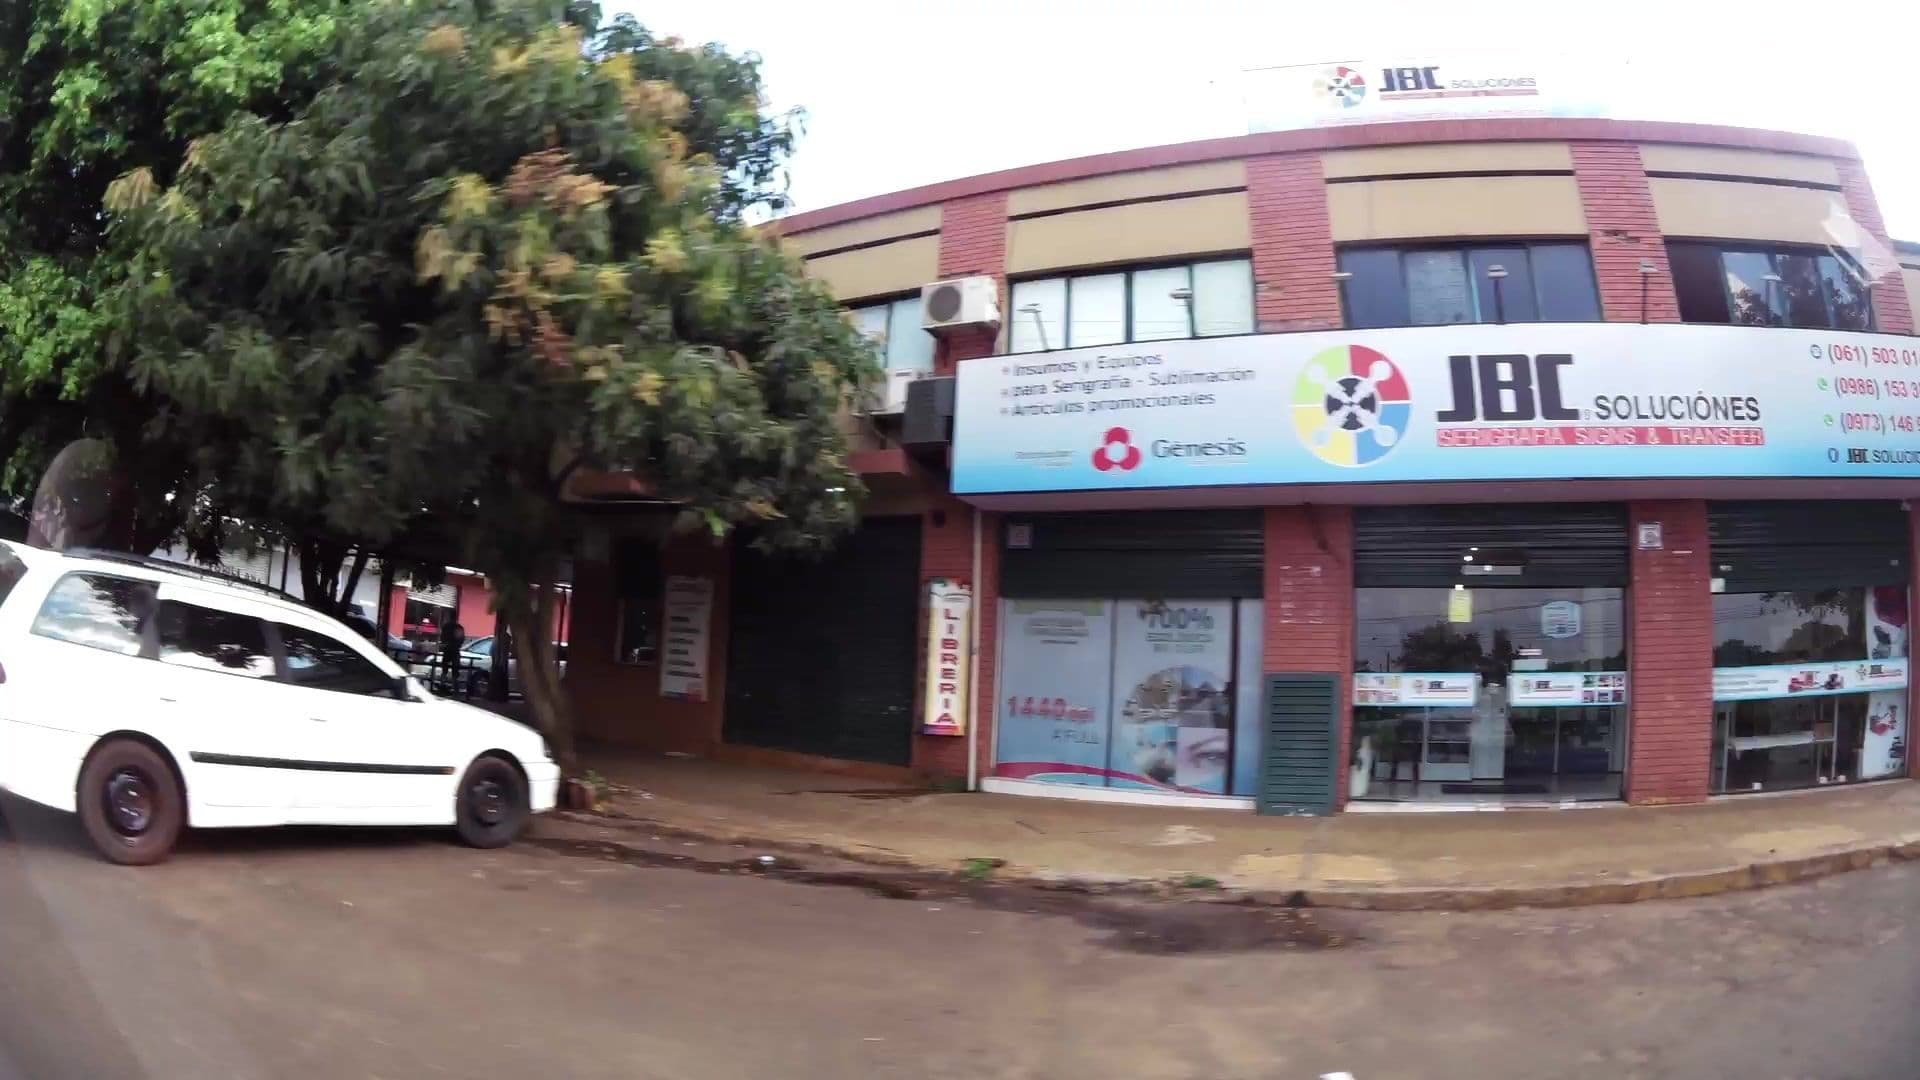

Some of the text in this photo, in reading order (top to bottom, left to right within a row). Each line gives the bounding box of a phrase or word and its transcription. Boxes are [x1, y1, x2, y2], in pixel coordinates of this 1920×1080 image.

[1379, 66, 1446, 93] JBC
[1014, 359, 1077, 377] Insumos
[1096, 353, 1164, 370] Equipos
[1828, 343, 1868, 368] (061)
[1872, 347, 1898, 365] 503
[1013, 382, 1047, 397] para
[1436, 353, 1761, 423] JBC SOLUCIÓNES
[1834, 376, 1880, 400] (0986)
[1884, 380, 1908, 399] 153
[1088, 391, 1216, 413] promocionales
[1840, 412, 1886, 436] (0973)
[1889, 415, 1913, 432] 146
[1438, 426, 1764, 447] SERIGRAFIA SIGNS & TRANSFER
[934, 607, 961, 725] LIBRERIA
